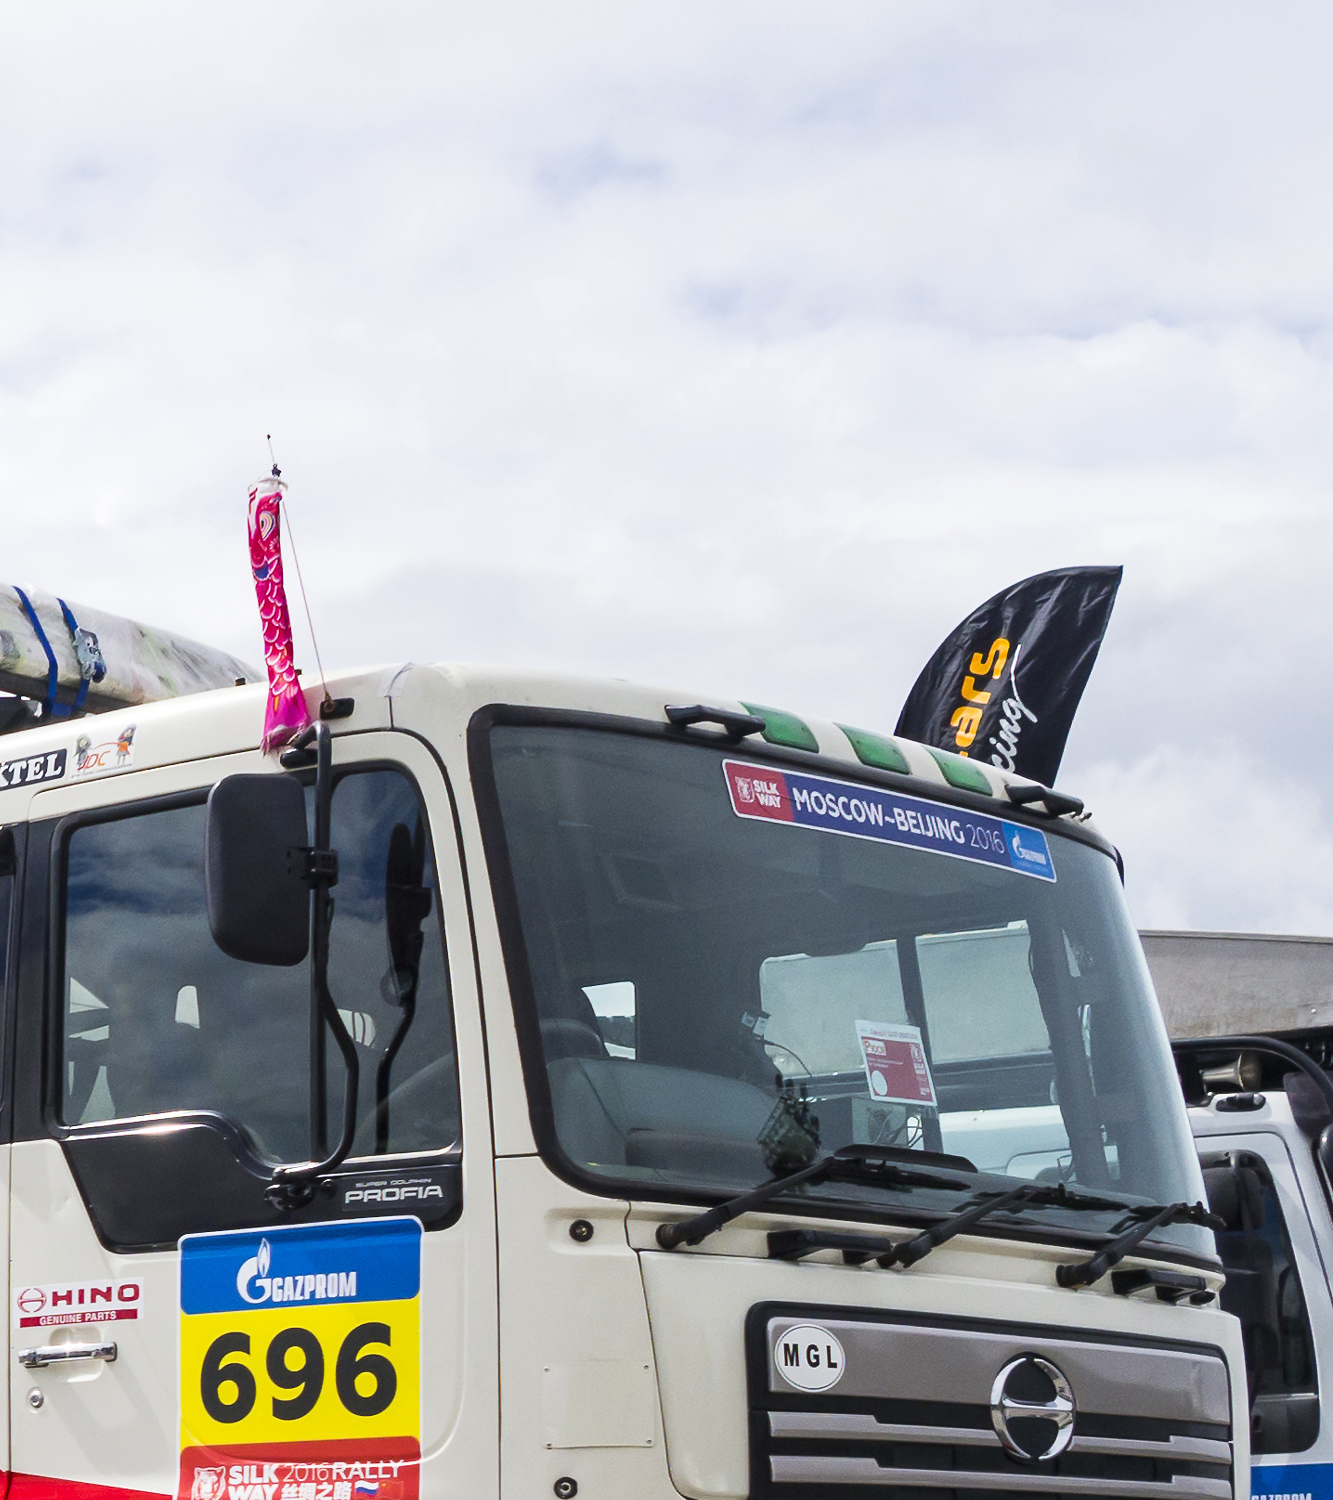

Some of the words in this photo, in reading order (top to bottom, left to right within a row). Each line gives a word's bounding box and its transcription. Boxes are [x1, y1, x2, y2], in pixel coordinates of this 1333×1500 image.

[950, 637, 1011, 758] ars
[753, 779, 780, 796] SILK
[755, 793, 783, 809] WAY
[966, 824, 1006, 855] 2016
[390, 1178, 432, 1186] DOLPHIN
[344, 1185, 444, 1204] PROFIA
[51, 1283, 140, 1307] HINO
[271, 1271, 358, 1302] GAZPROM
[39, 1313, 82, 1327] GENUINE
[85, 1310, 118, 1324] PARTS
[199, 1321, 398, 1425] 696
[228, 1463, 279, 1484] SILK
[282, 1463, 330, 1483] 2016
[332, 1459, 406, 1482] RALLY
